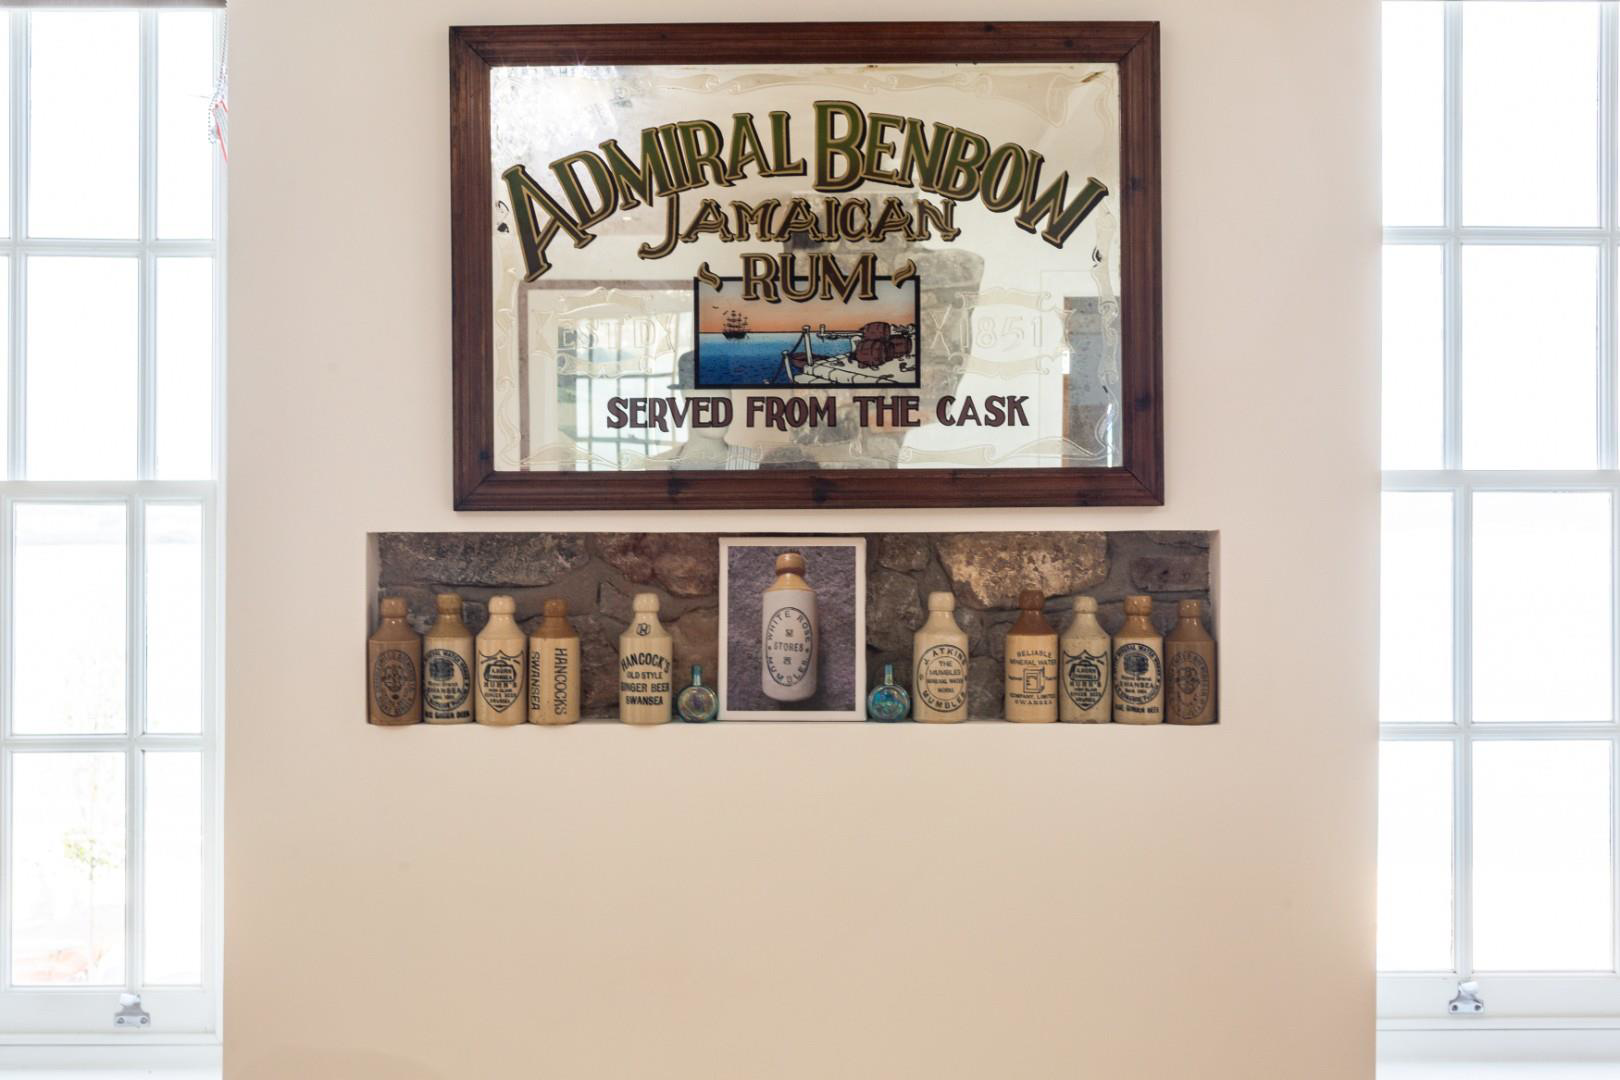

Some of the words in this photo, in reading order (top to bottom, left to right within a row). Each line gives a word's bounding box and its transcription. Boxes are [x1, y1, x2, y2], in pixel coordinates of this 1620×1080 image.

[501, 112, 807, 282] ADMIRAL
[812, 100, 1109, 249] BENBOW
[638, 193, 961, 260] JAMAICAN
[739, 252, 879, 304] RUM
[959, 315, 1043, 352] 1851
[606, 396, 733, 432] SERVED
[746, 396, 837, 432] FROM
[854, 396, 921, 428] THE
[936, 395, 1030, 428] CASK
[767, 610, 791, 640] WHITE
[796, 614, 811, 643] ROSE
[621, 652, 671, 673] HANCOCK'S
[773, 642, 805, 653] STORES
[531, 651, 540, 711] SWANSEA
[554, 647, 568, 715] HANCOCKS
[641, 671, 663, 680] STYLE
[651, 682, 670, 693] BEER
[626, 695, 664, 706] SWANSEA
